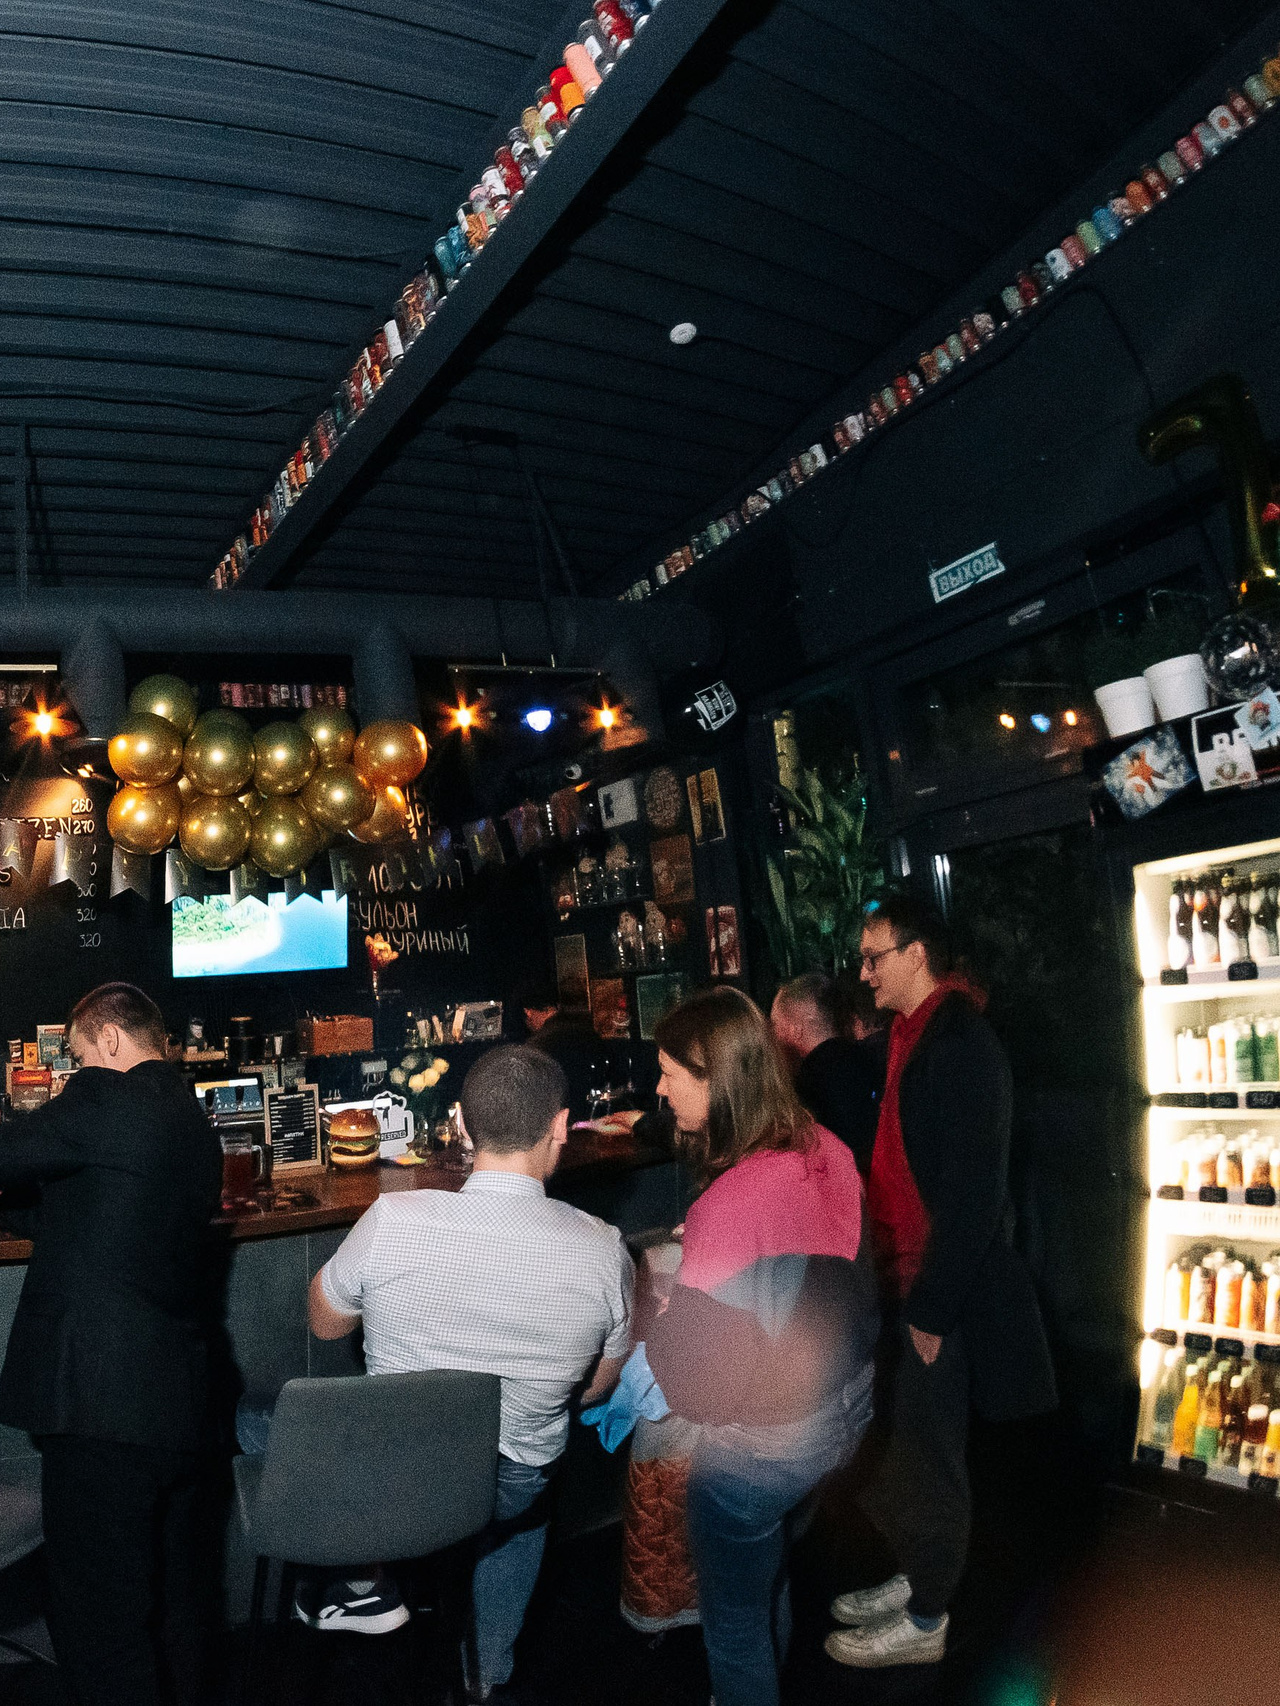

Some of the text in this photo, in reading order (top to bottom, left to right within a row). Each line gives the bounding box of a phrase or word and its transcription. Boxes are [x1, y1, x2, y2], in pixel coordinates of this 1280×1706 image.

[938, 551, 997, 593] ВЫХОД
[71, 798, 94, 814] 260
[73, 819, 95, 835] 270
[76, 907, 97, 923] 320
[79, 932, 101, 948] 320
[386, 924, 471, 955] УРИНЫЙ
